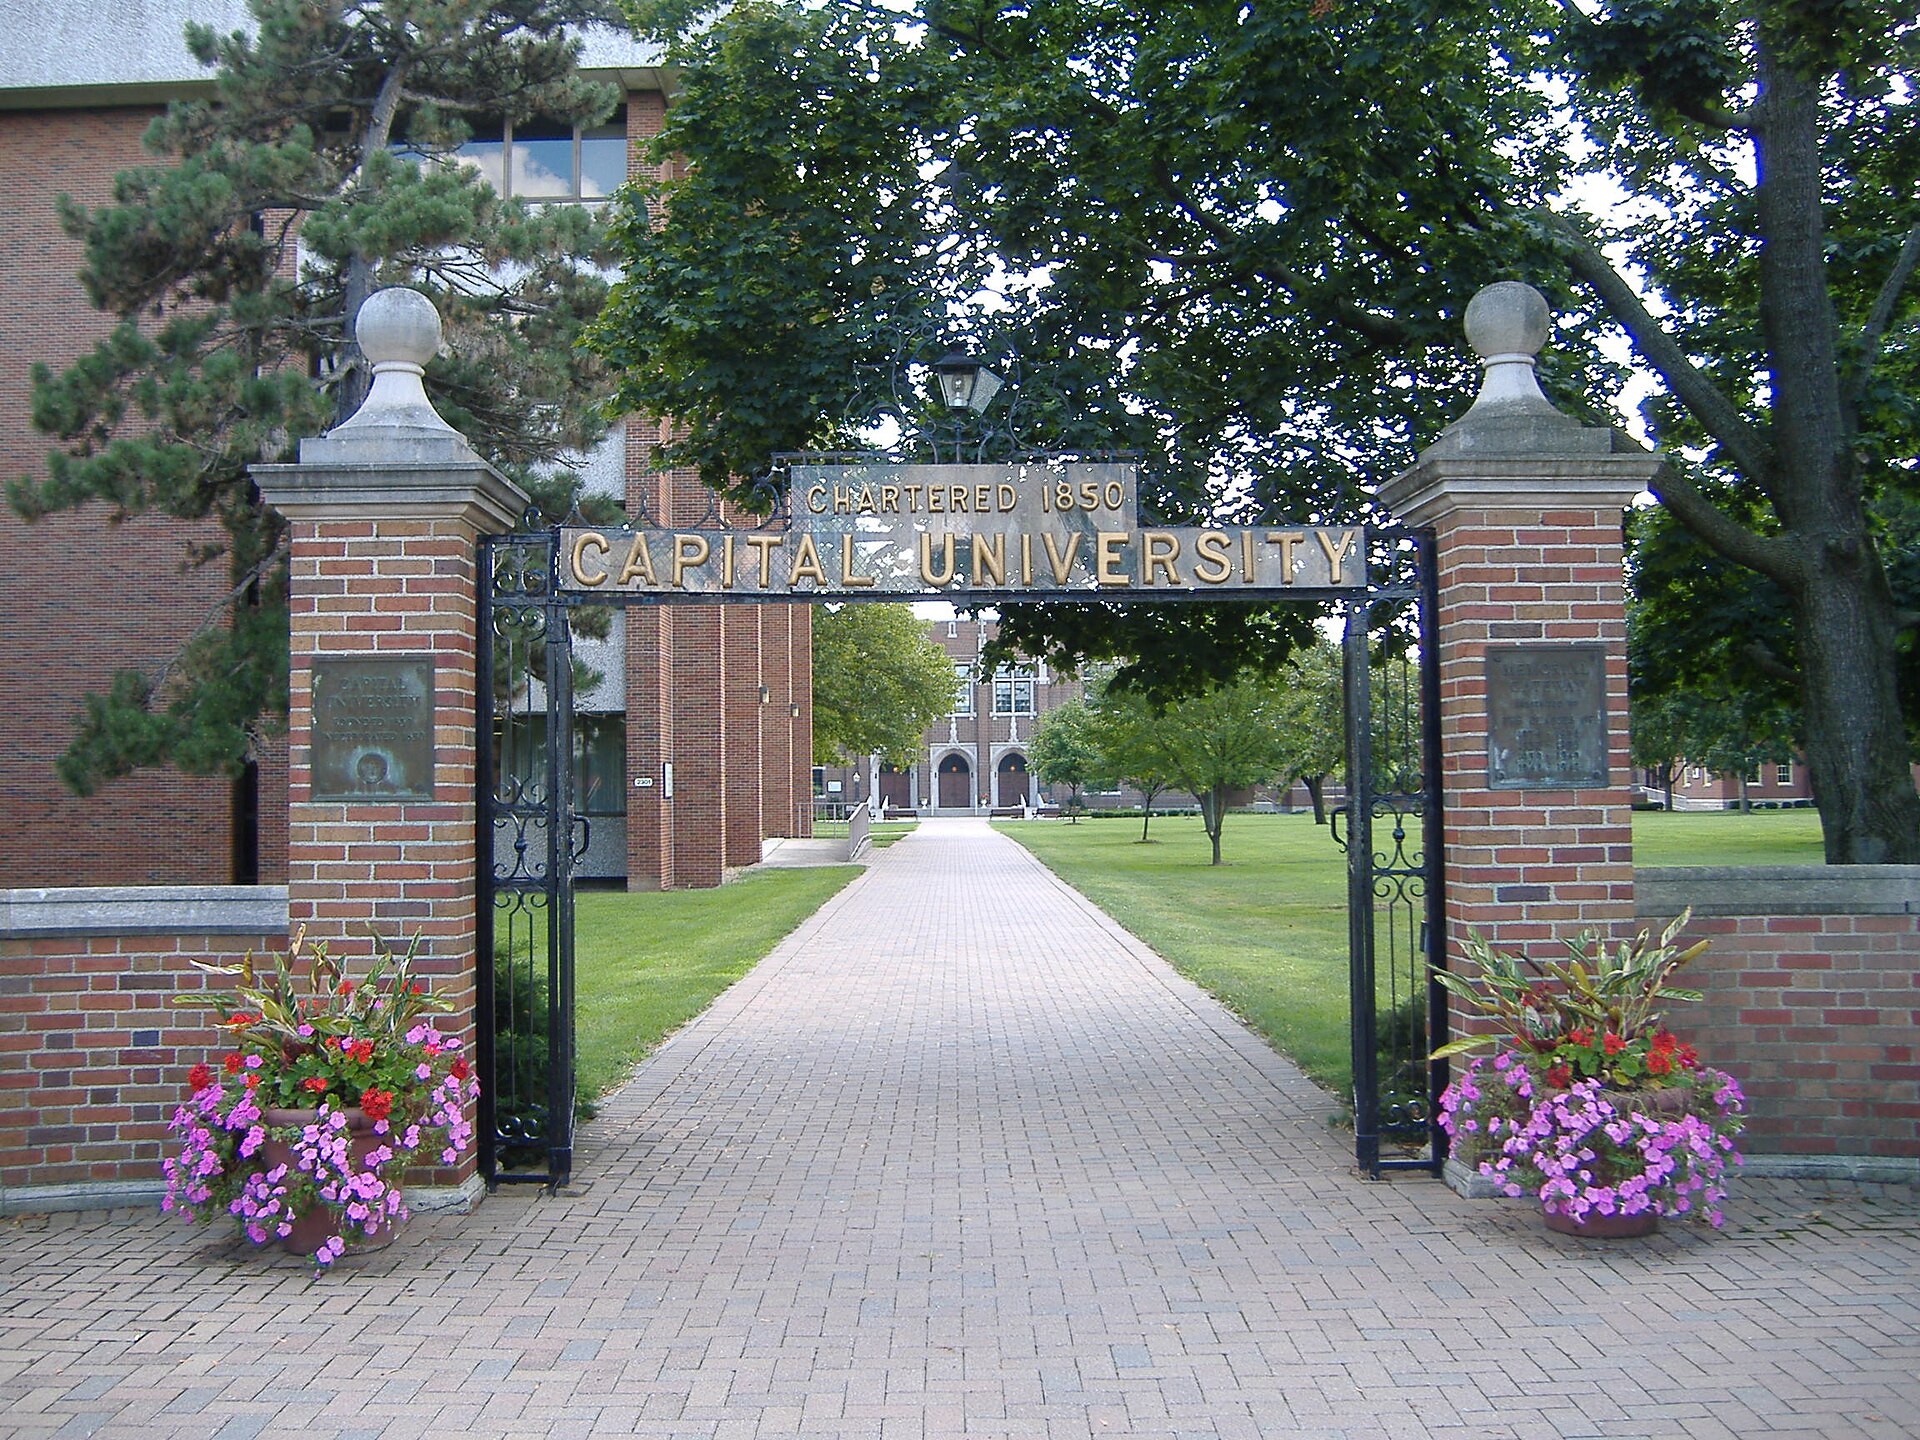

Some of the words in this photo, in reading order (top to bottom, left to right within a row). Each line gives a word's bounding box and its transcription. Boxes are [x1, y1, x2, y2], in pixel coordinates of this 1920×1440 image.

[806, 483, 1018, 514] CHARTERED
[1041, 481, 1125, 512] 1850
[570, 531, 875, 589] CAPITAL
[919, 530, 1355, 586] UNIVERSITY
